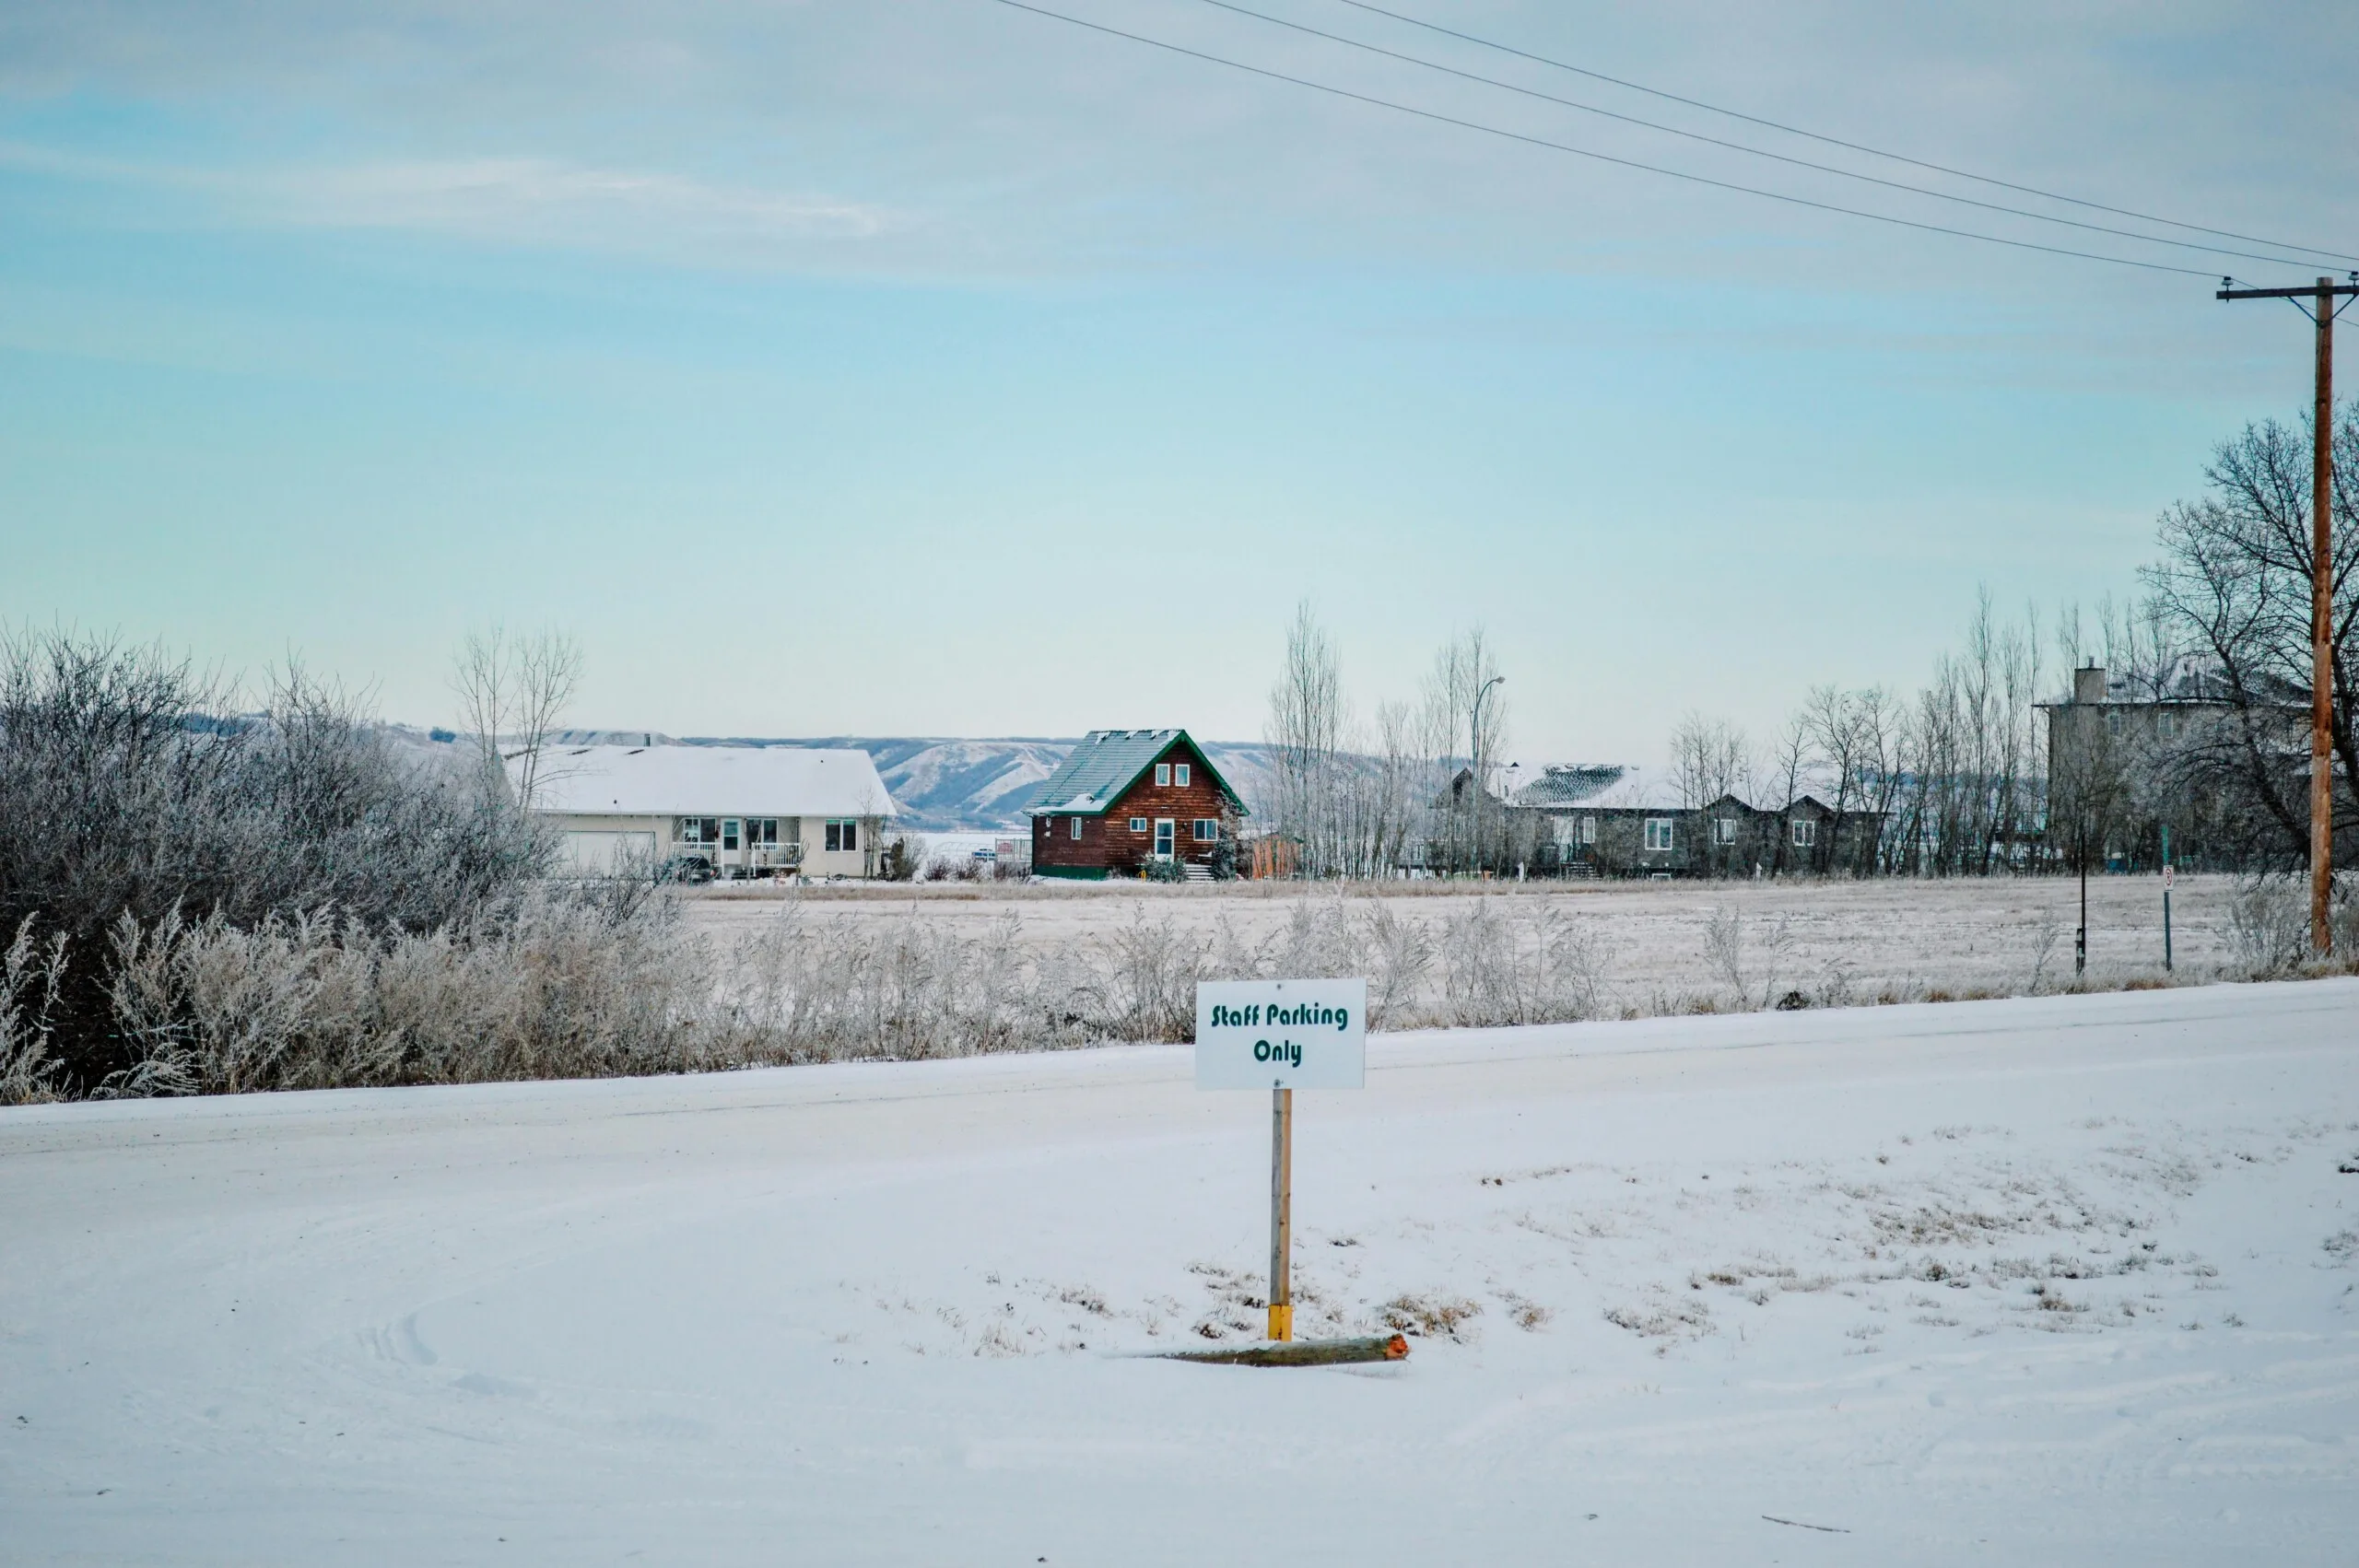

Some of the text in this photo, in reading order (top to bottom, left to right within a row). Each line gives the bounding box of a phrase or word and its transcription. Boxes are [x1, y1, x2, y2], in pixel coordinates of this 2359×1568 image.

[1211, 1001, 1349, 1032] Staff Parking
[1253, 1039, 1302, 1069] Only
